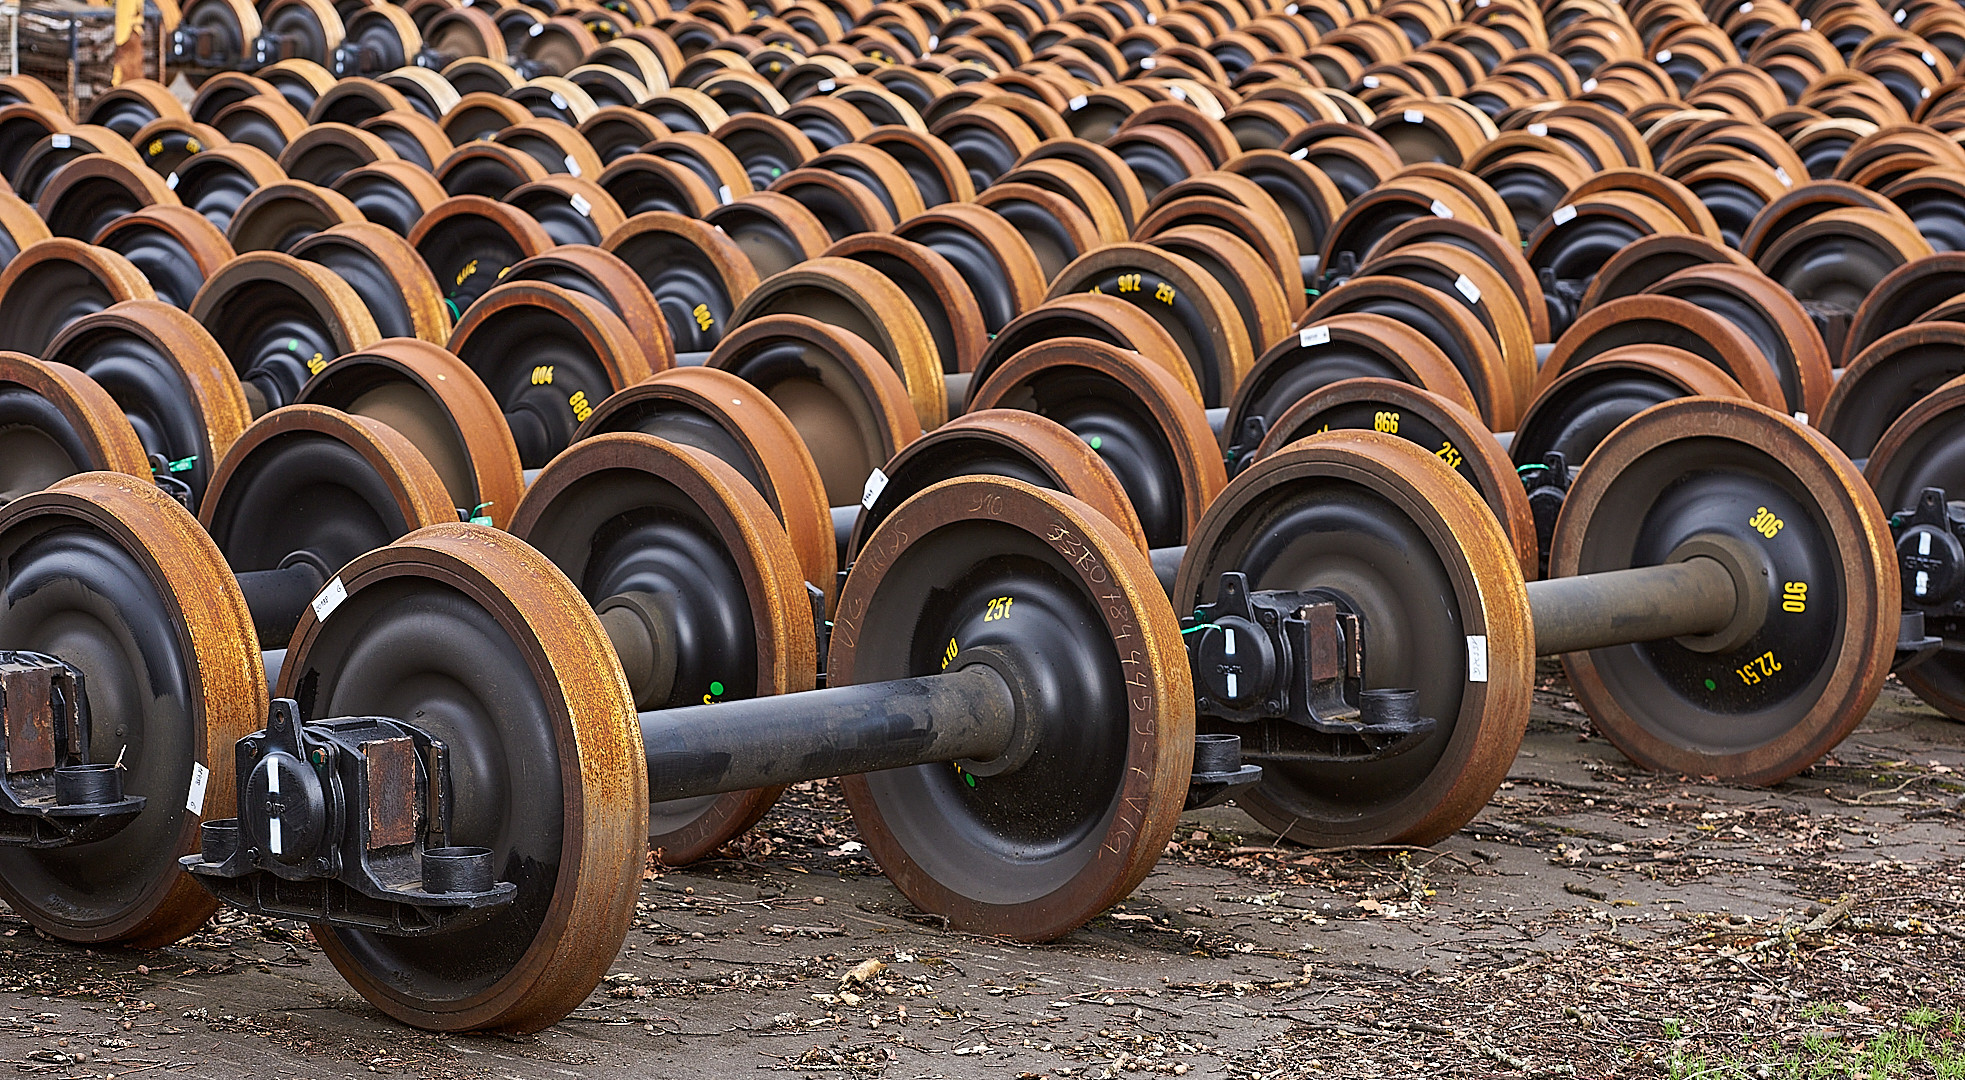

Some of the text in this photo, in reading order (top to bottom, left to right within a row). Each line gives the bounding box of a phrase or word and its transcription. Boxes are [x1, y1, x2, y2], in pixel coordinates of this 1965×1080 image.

[1117, 273, 1141, 293] 902
[1154, 282, 1176, 306] 25t
[1374, 411, 1463, 470] 866 25t
[983, 596, 1014, 623] 25t
[1735, 506, 1808, 686] 306 910 22.5t
